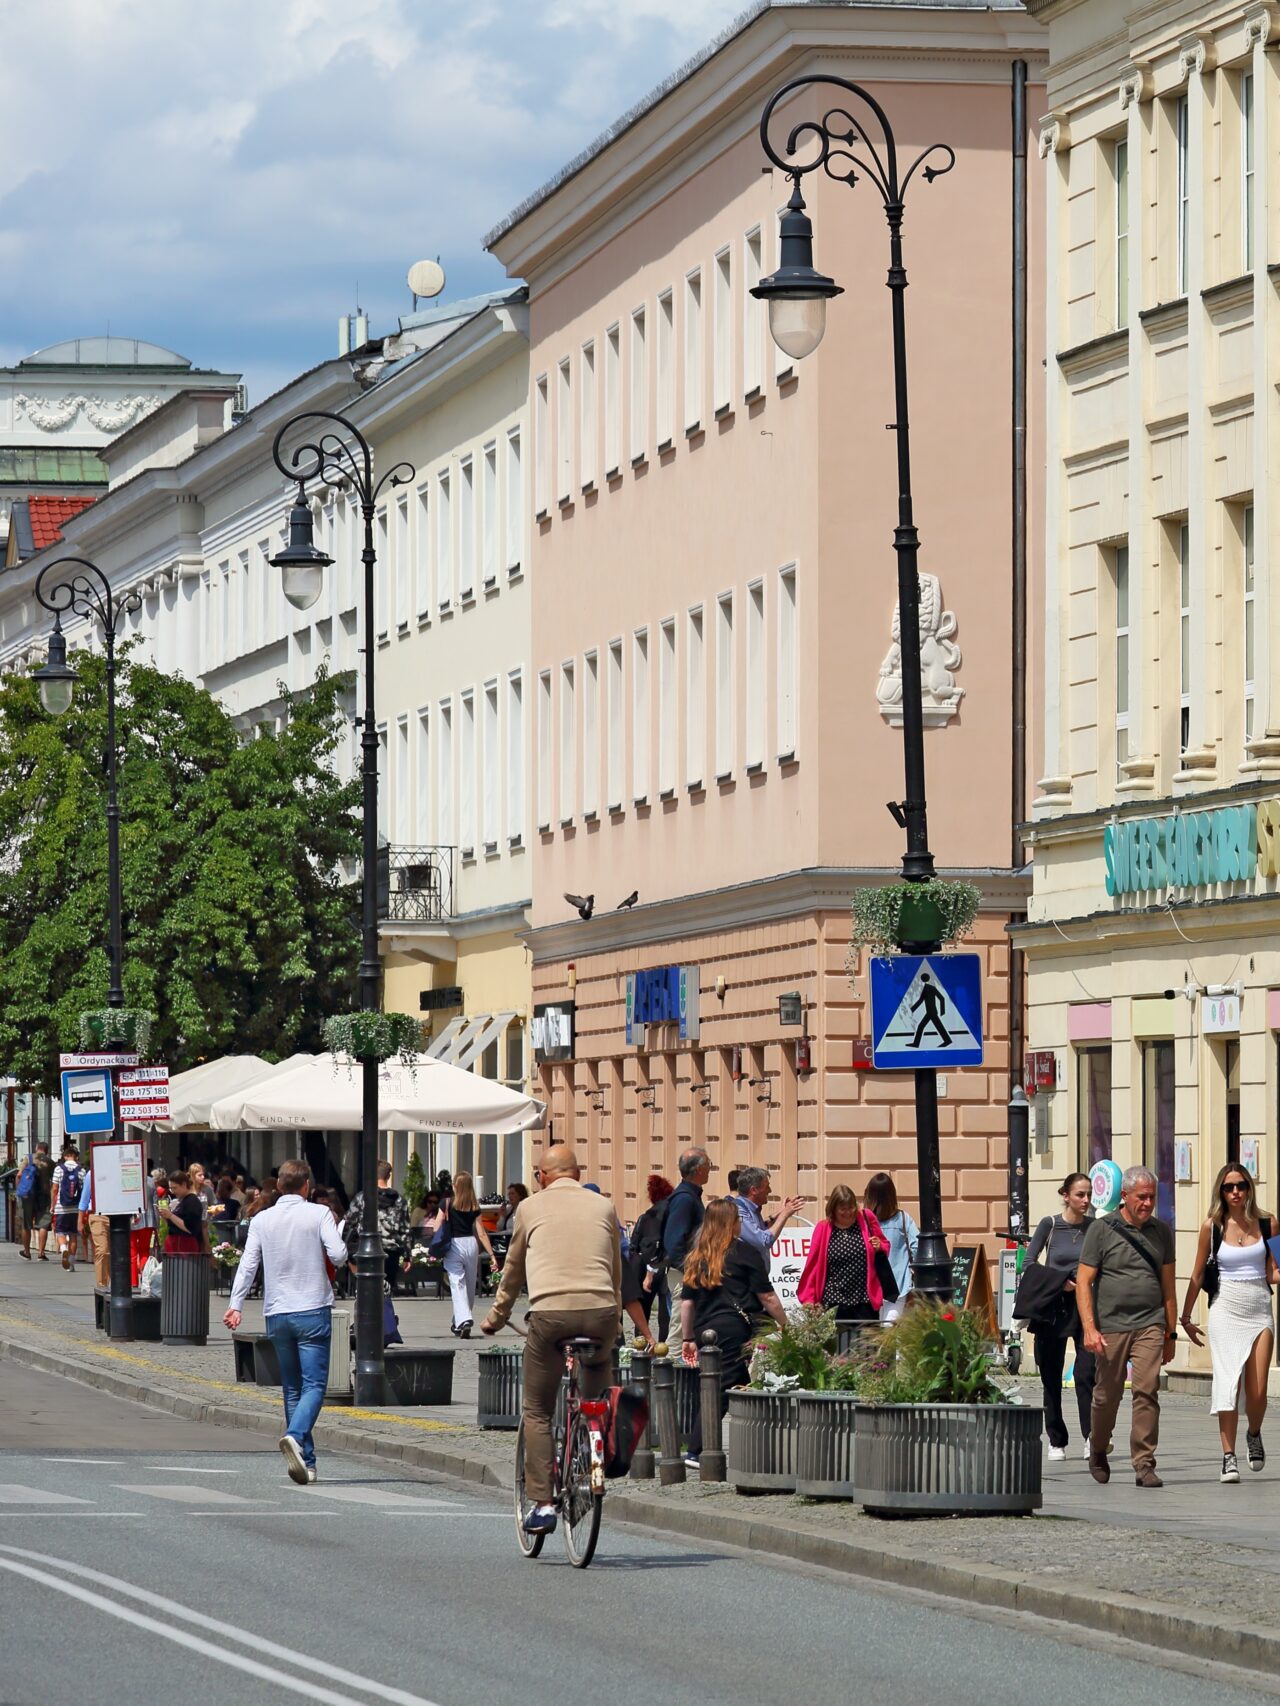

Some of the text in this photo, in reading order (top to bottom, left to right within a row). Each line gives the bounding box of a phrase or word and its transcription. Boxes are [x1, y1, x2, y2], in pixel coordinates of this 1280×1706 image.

[1104, 818, 1166, 897] SWEET
[79, 1056, 138, 1066] Ordynacka 02
[154, 1068, 166, 1077] 116
[121, 1086, 168, 1097] 128 175 180
[122, 1105, 168, 1115] 222 503 518
[259, 1115, 283, 1123] FIND
[419, 1119, 464, 1128] FIND TEA
[771, 1238, 811, 1258] UTLE
[772, 1275, 801, 1283] LACOS
[782, 1288, 796, 1298] D&
